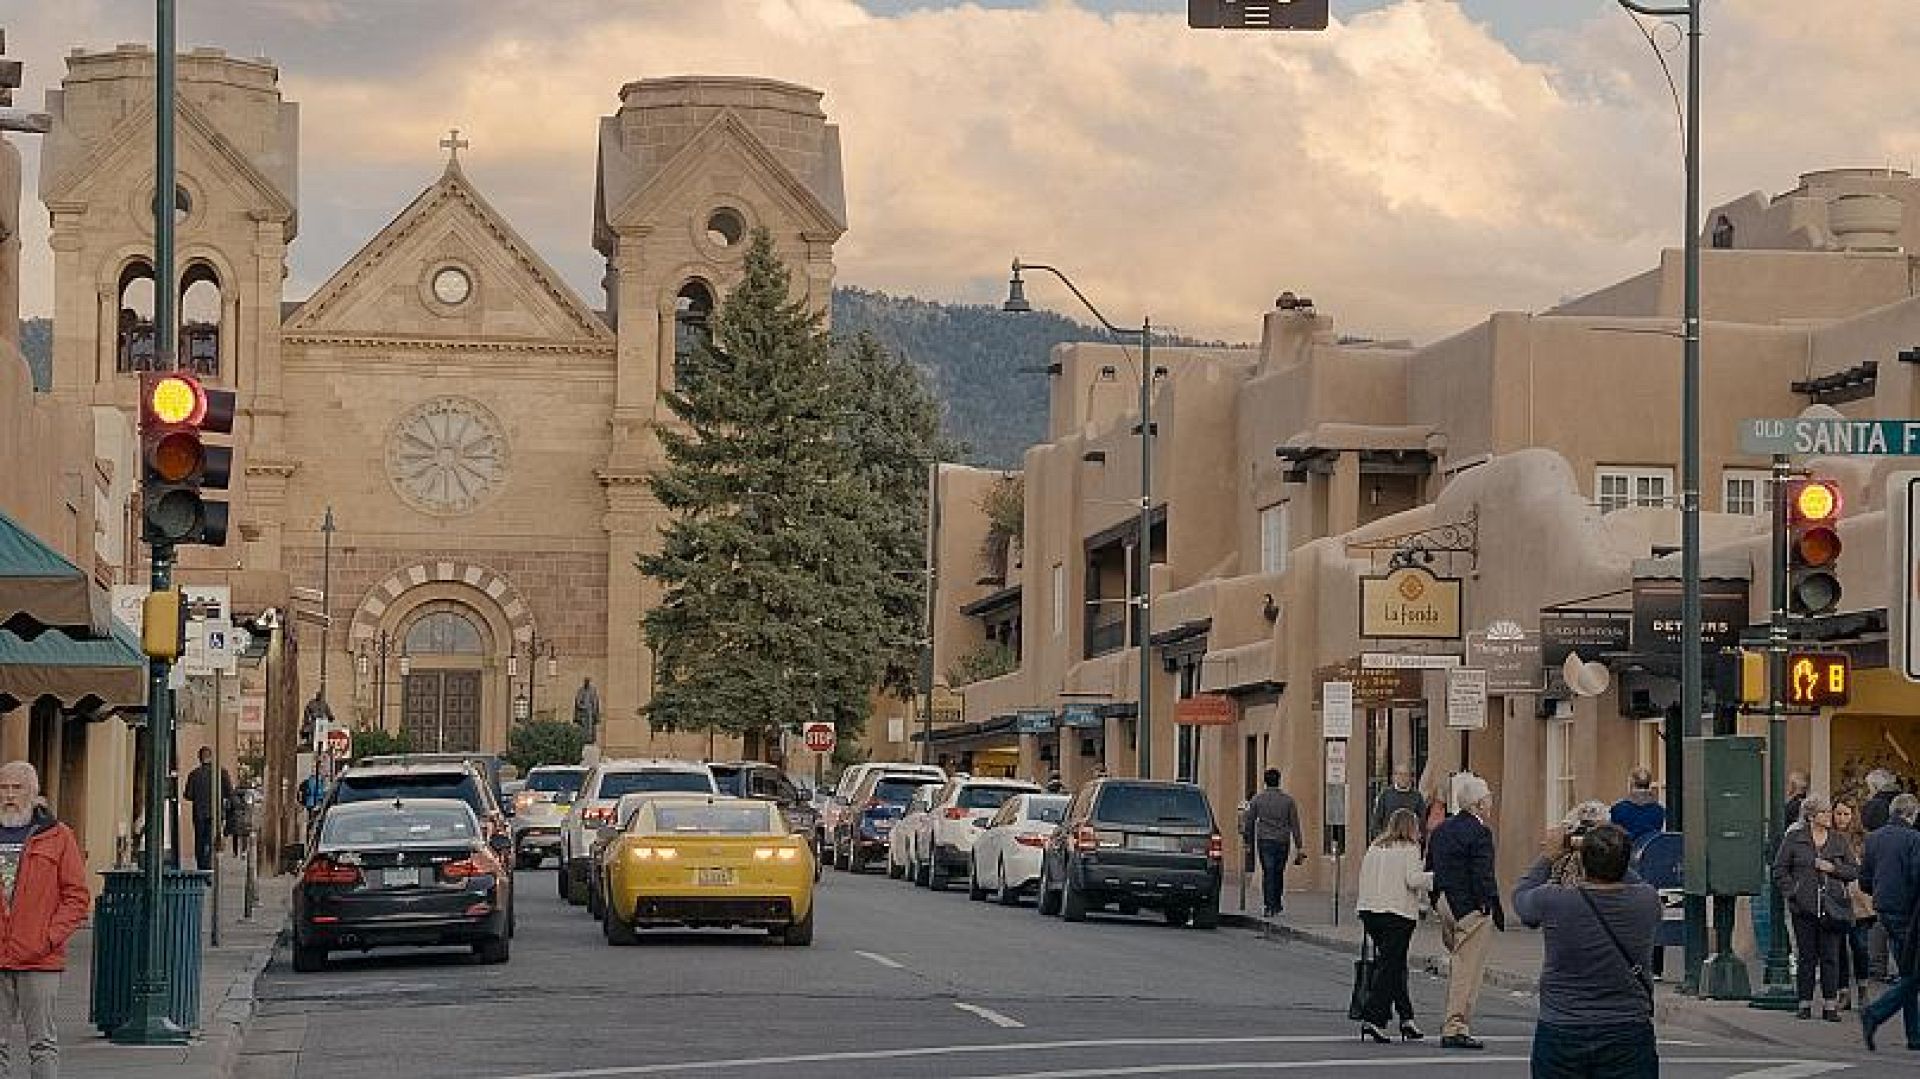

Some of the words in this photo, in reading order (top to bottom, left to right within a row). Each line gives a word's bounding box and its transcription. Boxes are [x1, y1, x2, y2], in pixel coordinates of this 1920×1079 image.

[1755, 421, 1784, 438] OLD
[1794, 422, 1887, 453] SANTA
[1385, 602, 1398, 622] La
[1653, 619, 1729, 633] DETRS
[1829, 664, 1845, 692] 8
[806, 731, 835, 745] STOP
